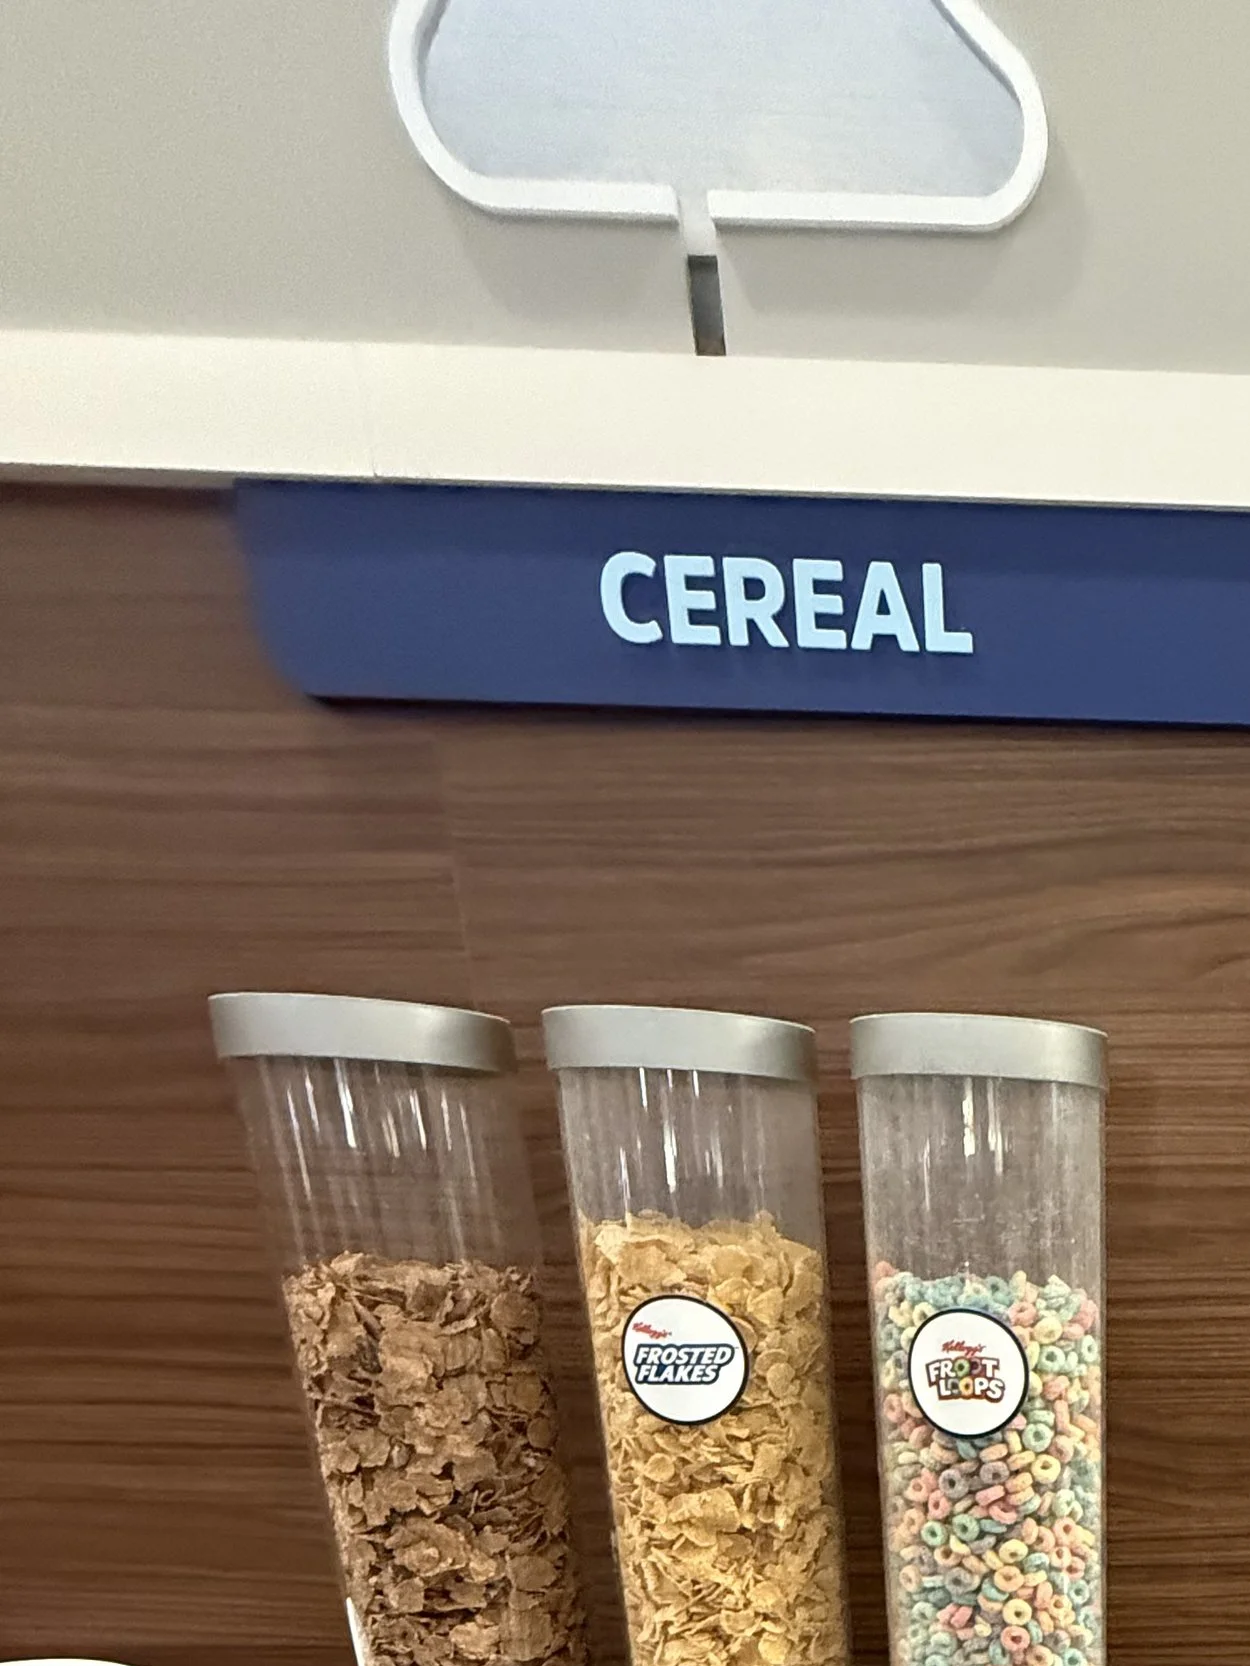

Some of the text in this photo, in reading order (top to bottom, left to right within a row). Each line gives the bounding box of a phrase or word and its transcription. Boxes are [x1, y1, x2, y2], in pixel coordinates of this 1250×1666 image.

[600, 550, 974, 654] CEREAL
[635, 1345, 734, 1366] FROSTED
[636, 1364, 719, 1383] FLAKES
[926, 1357, 1000, 1386] FROOT
[938, 1376, 1005, 1402] LOOPS
